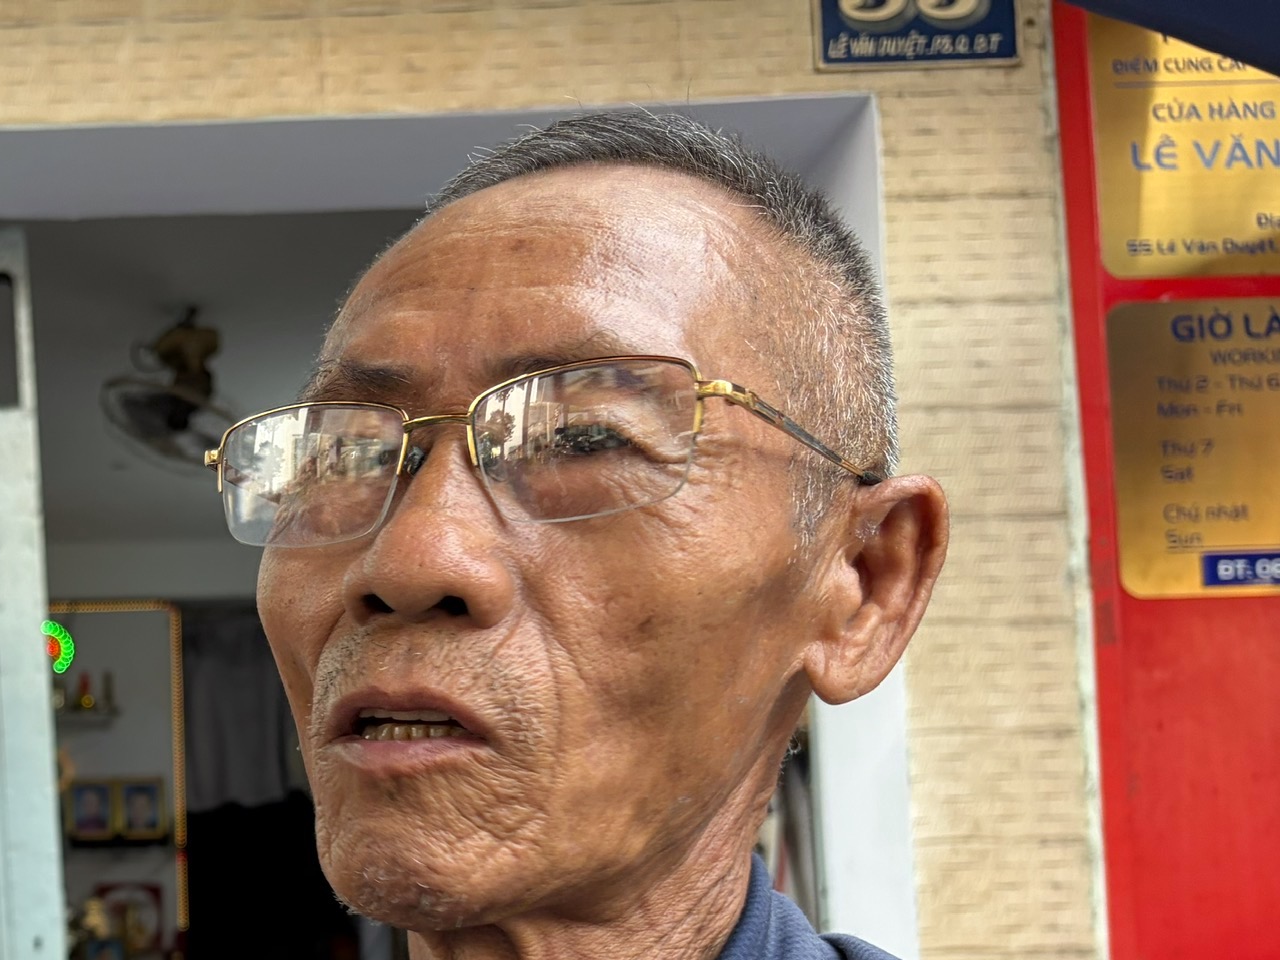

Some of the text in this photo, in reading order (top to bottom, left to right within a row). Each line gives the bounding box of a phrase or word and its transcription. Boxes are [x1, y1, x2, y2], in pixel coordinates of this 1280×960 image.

[1163, 56, 1214, 73] CUNG
[1208, 97, 1277, 121] HÀNG
[1130, 133, 1280, 171] LÊ VĂN
